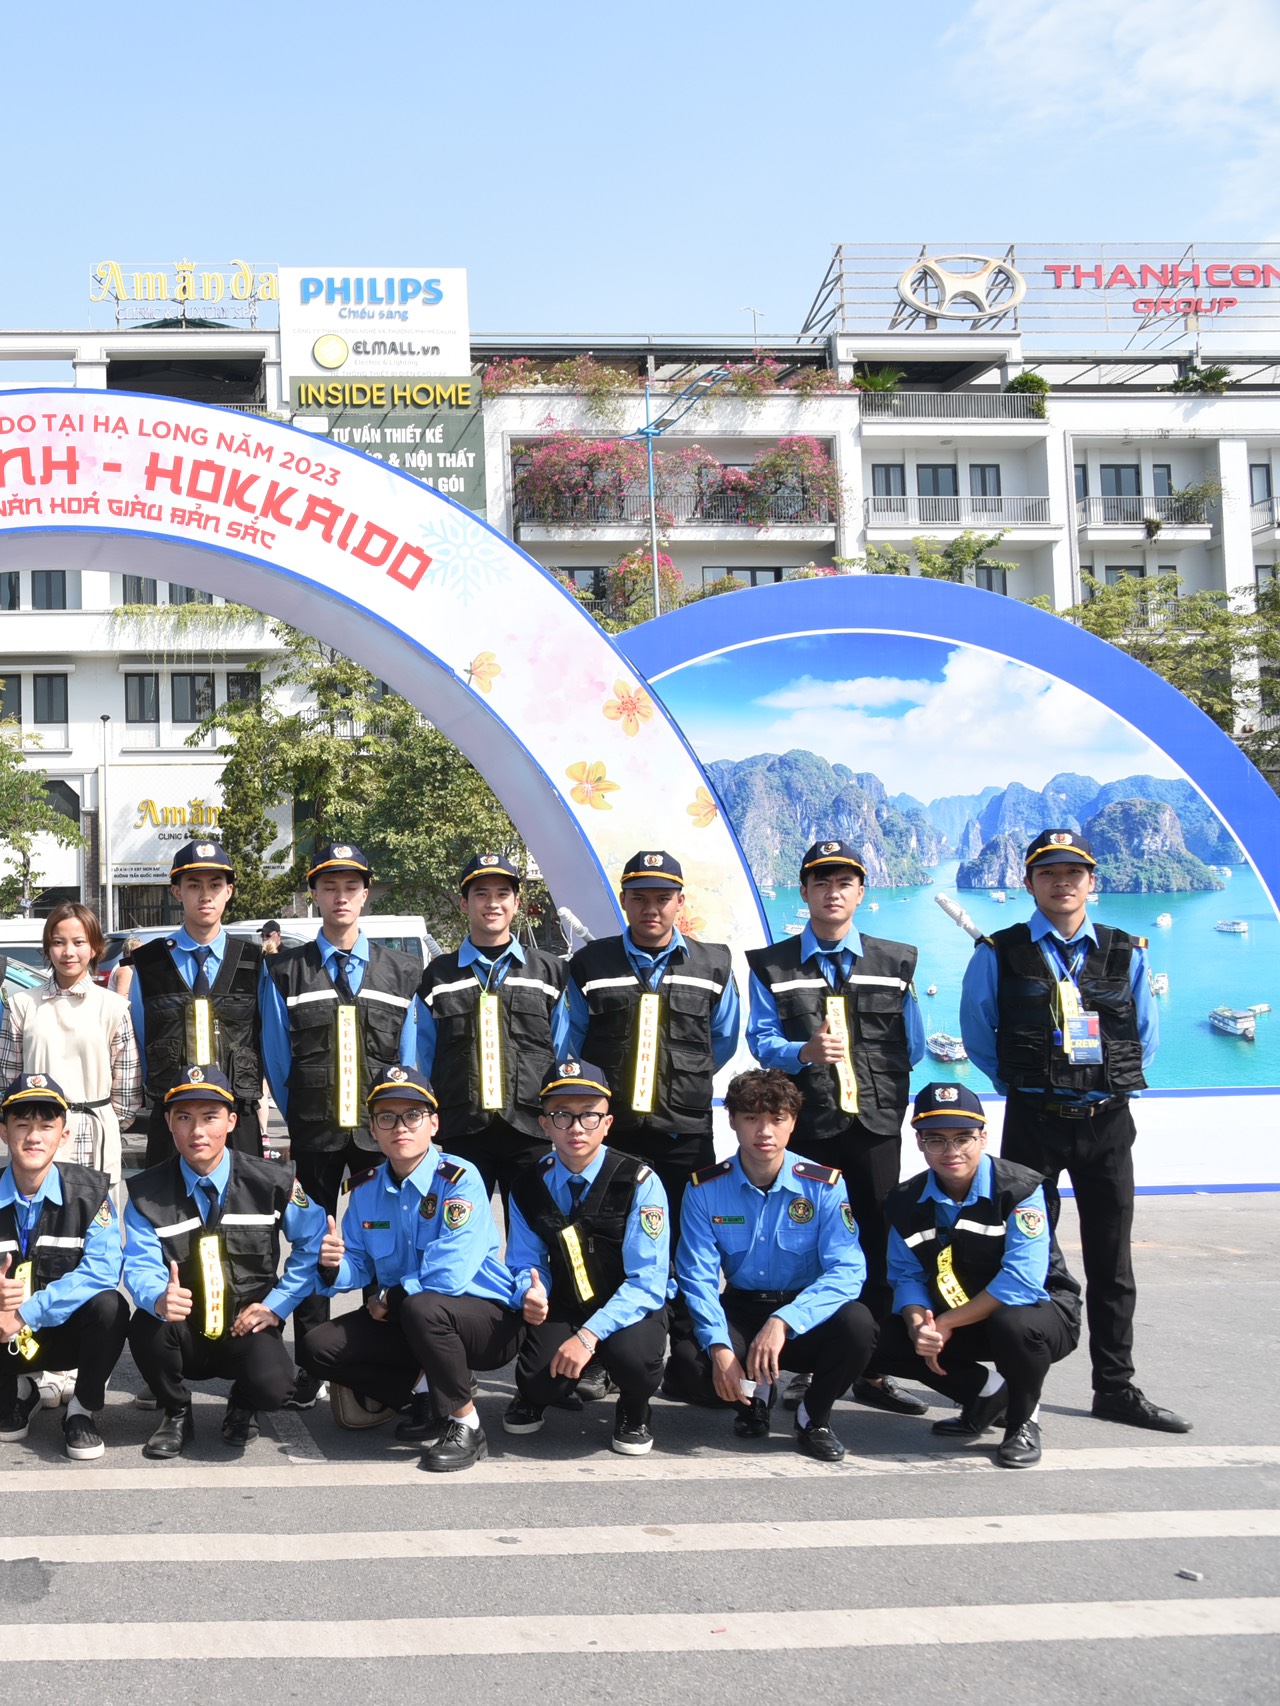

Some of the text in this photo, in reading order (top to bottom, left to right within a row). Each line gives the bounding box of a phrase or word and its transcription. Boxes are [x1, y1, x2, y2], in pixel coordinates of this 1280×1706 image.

[1044, 264, 1280, 288] THANHCON
[300, 277, 444, 305] PHILIPS
[116, 308, 161, 319] CLINIC
[378, 307, 409, 321] sáng
[1133, 297, 1238, 314] GROUP
[389, 359, 418, 368] Lighting
[298, 382, 472, 405] INSIDE HOME
[332, 423, 444, 444] TƯ VẤN THIẾT KẾ
[42, 413, 84, 437] TẠI
[93, 415, 129, 440] HẠ
[138, 421, 208, 447] LONG
[216, 432, 274, 463] NĂM
[279, 452, 341, 487] 2023
[405, 452, 433, 471] NỘI
[437, 448, 476, 468] THẤT
[438, 472, 465, 493] GÓI
[50, 490, 100, 515] HOÁ
[107, 494, 163, 521] GIÀU
[170, 503, 221, 533] BẢN
[226, 515, 276, 550] SẮC
[144, 451, 433, 591] HOKKAIDO
[134, 797, 222, 828] Aman
[158, 833, 183, 841] CLINIC
[485, 1006, 495, 1097] SECURITY
[639, 1005, 652, 1098] SECURITY
[832, 1008, 853, 1101] SECITY
[1069, 1039, 1100, 1049] CREW
[343, 1017, 353, 1113] SECURITY
